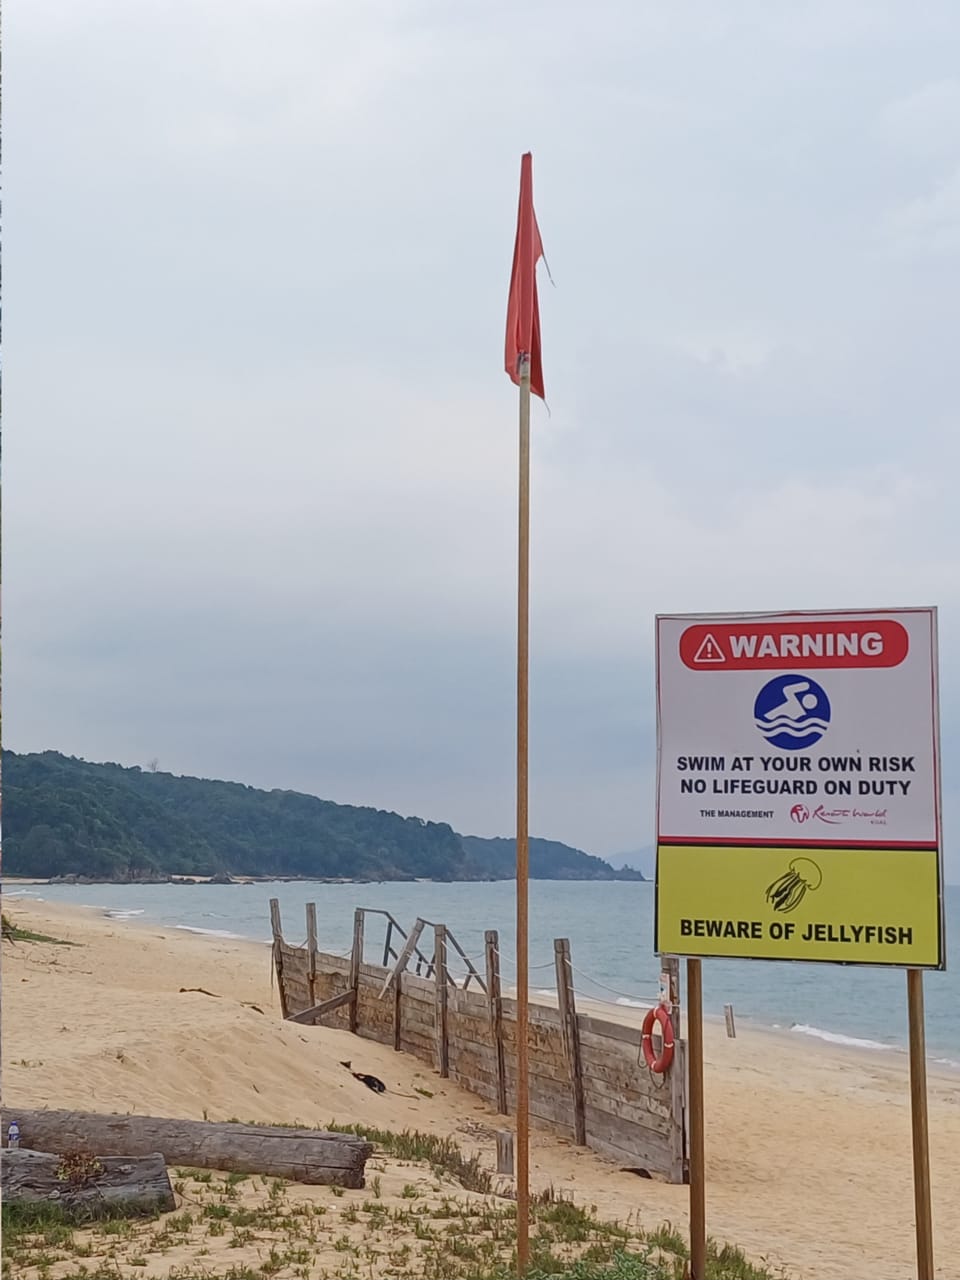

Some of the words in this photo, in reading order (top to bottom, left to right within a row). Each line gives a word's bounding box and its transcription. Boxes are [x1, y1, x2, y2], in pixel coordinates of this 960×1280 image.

[729, 631, 884, 659] WARNING
[676, 756, 726, 772] SWIM
[731, 756, 754, 772] AT
[761, 756, 812, 773] YOUR
[817, 756, 862, 773] OWN
[868, 756, 916, 773] RISK
[680, 778, 707, 795] NO
[712, 778, 818, 796] LIFEGUARD
[823, 779, 852, 796] ON
[858, 780, 912, 797] DUTY
[700, 809, 716, 818] THE
[717, 809, 775, 819] MANAGEMENT
[680, 918, 763, 940] BEWARE
[768, 921, 796, 941] OF
[801, 923, 913, 945] JELLYFISH
